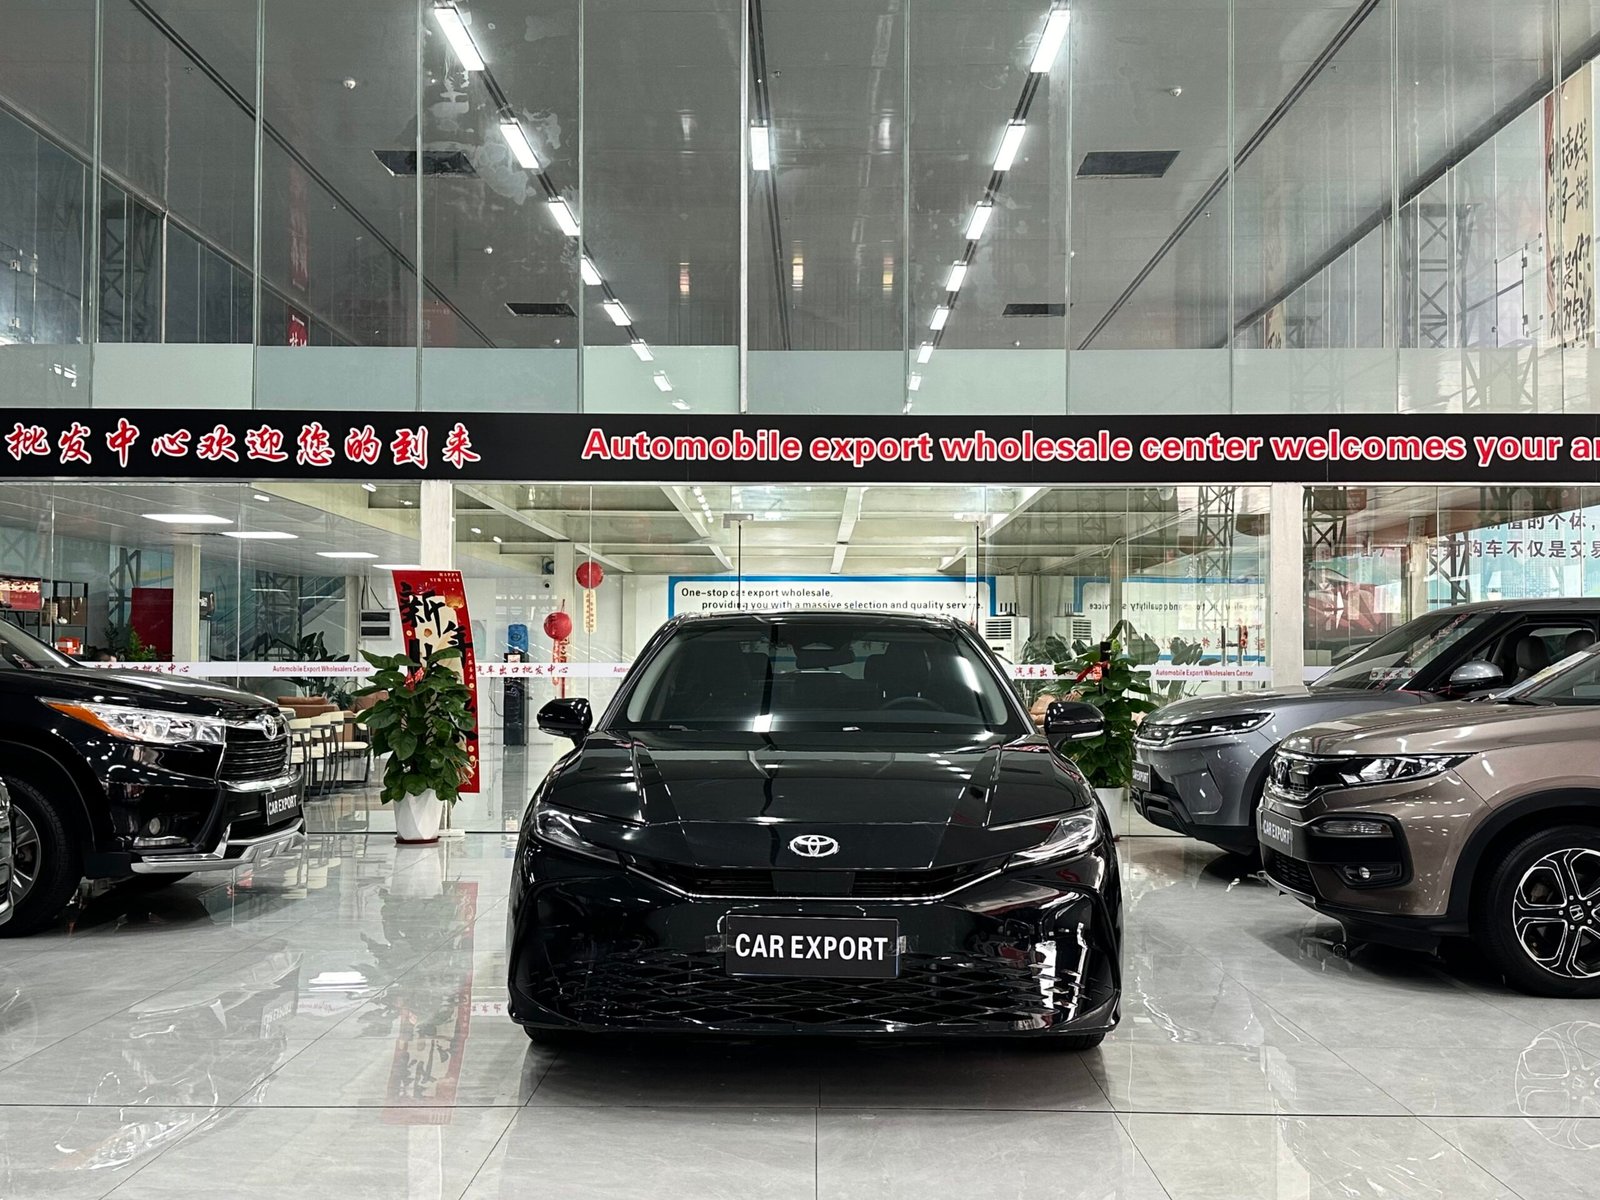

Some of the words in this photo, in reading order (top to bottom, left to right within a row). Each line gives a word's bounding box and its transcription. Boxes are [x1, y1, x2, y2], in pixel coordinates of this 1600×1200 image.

[5, 417, 481, 469] 批发中心欢迎您的到来
[580, 429, 803, 461] Automobile
[810, 432, 934, 467] export
[938, 429, 1133, 461] wholesale
[1139, 431, 1264, 461] center
[1269, 429, 1467, 460] welcomes
[1474, 436, 1564, 467] your
[681, 587, 729, 599] One-stop
[747, 588, 779, 600] export
[781, 587, 834, 599] wholesale,
[702, 600, 749, 611] providig
[751, 602, 769, 610] you
[770, 600, 792, 610] with
[802, 601, 842, 610] massive
[844, 600, 888, 610] selection
[890, 600, 908, 609] and
[910, 600, 944, 611] quality
[272, 665, 303, 673] Automobile
[303, 665, 320, 673] Export
[353, 665, 370, 673] Center
[1236, 669, 1253, 677] Center
[268, 801, 278, 815] CAR
[279, 794, 297, 812] EXPORT
[1263, 819, 1271, 836] CAR
[1272, 823, 1290, 845] EXPORT
[735, 933, 784, 959] CAR
[790, 935, 889, 961] EXPORT
